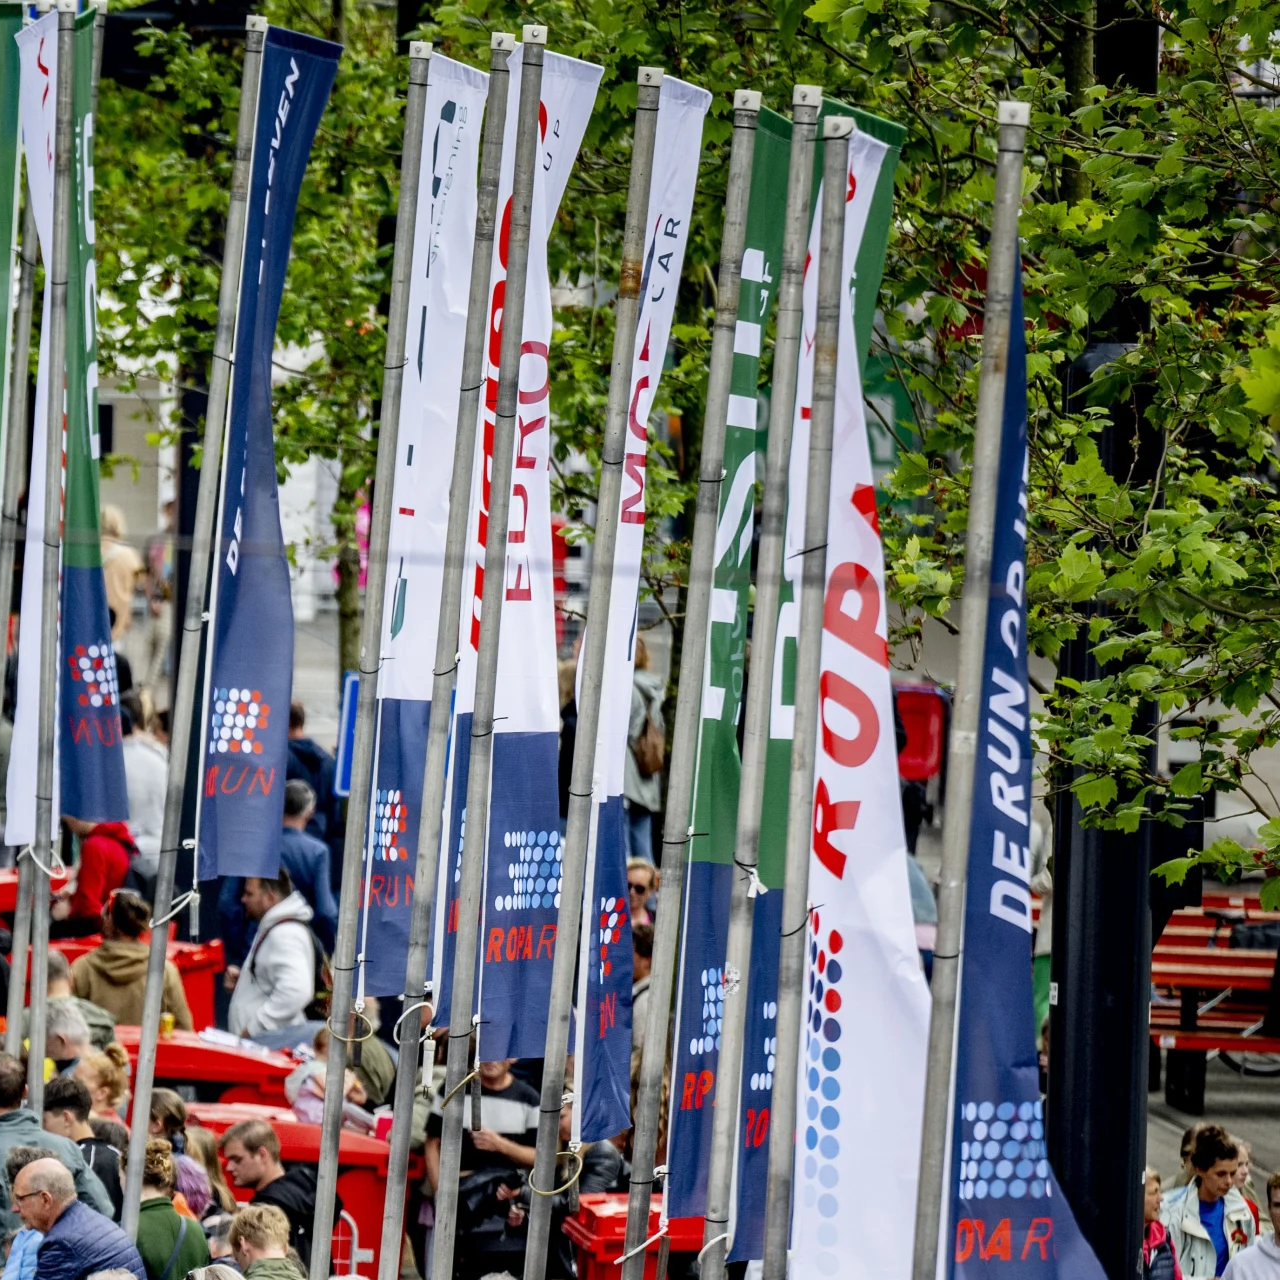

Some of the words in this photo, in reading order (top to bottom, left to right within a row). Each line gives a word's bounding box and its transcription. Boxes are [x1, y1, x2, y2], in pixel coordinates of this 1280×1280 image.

[987, 667, 1030, 827] RUN
[987, 822, 1032, 936] DE
[486, 924, 558, 963] ROPAR
